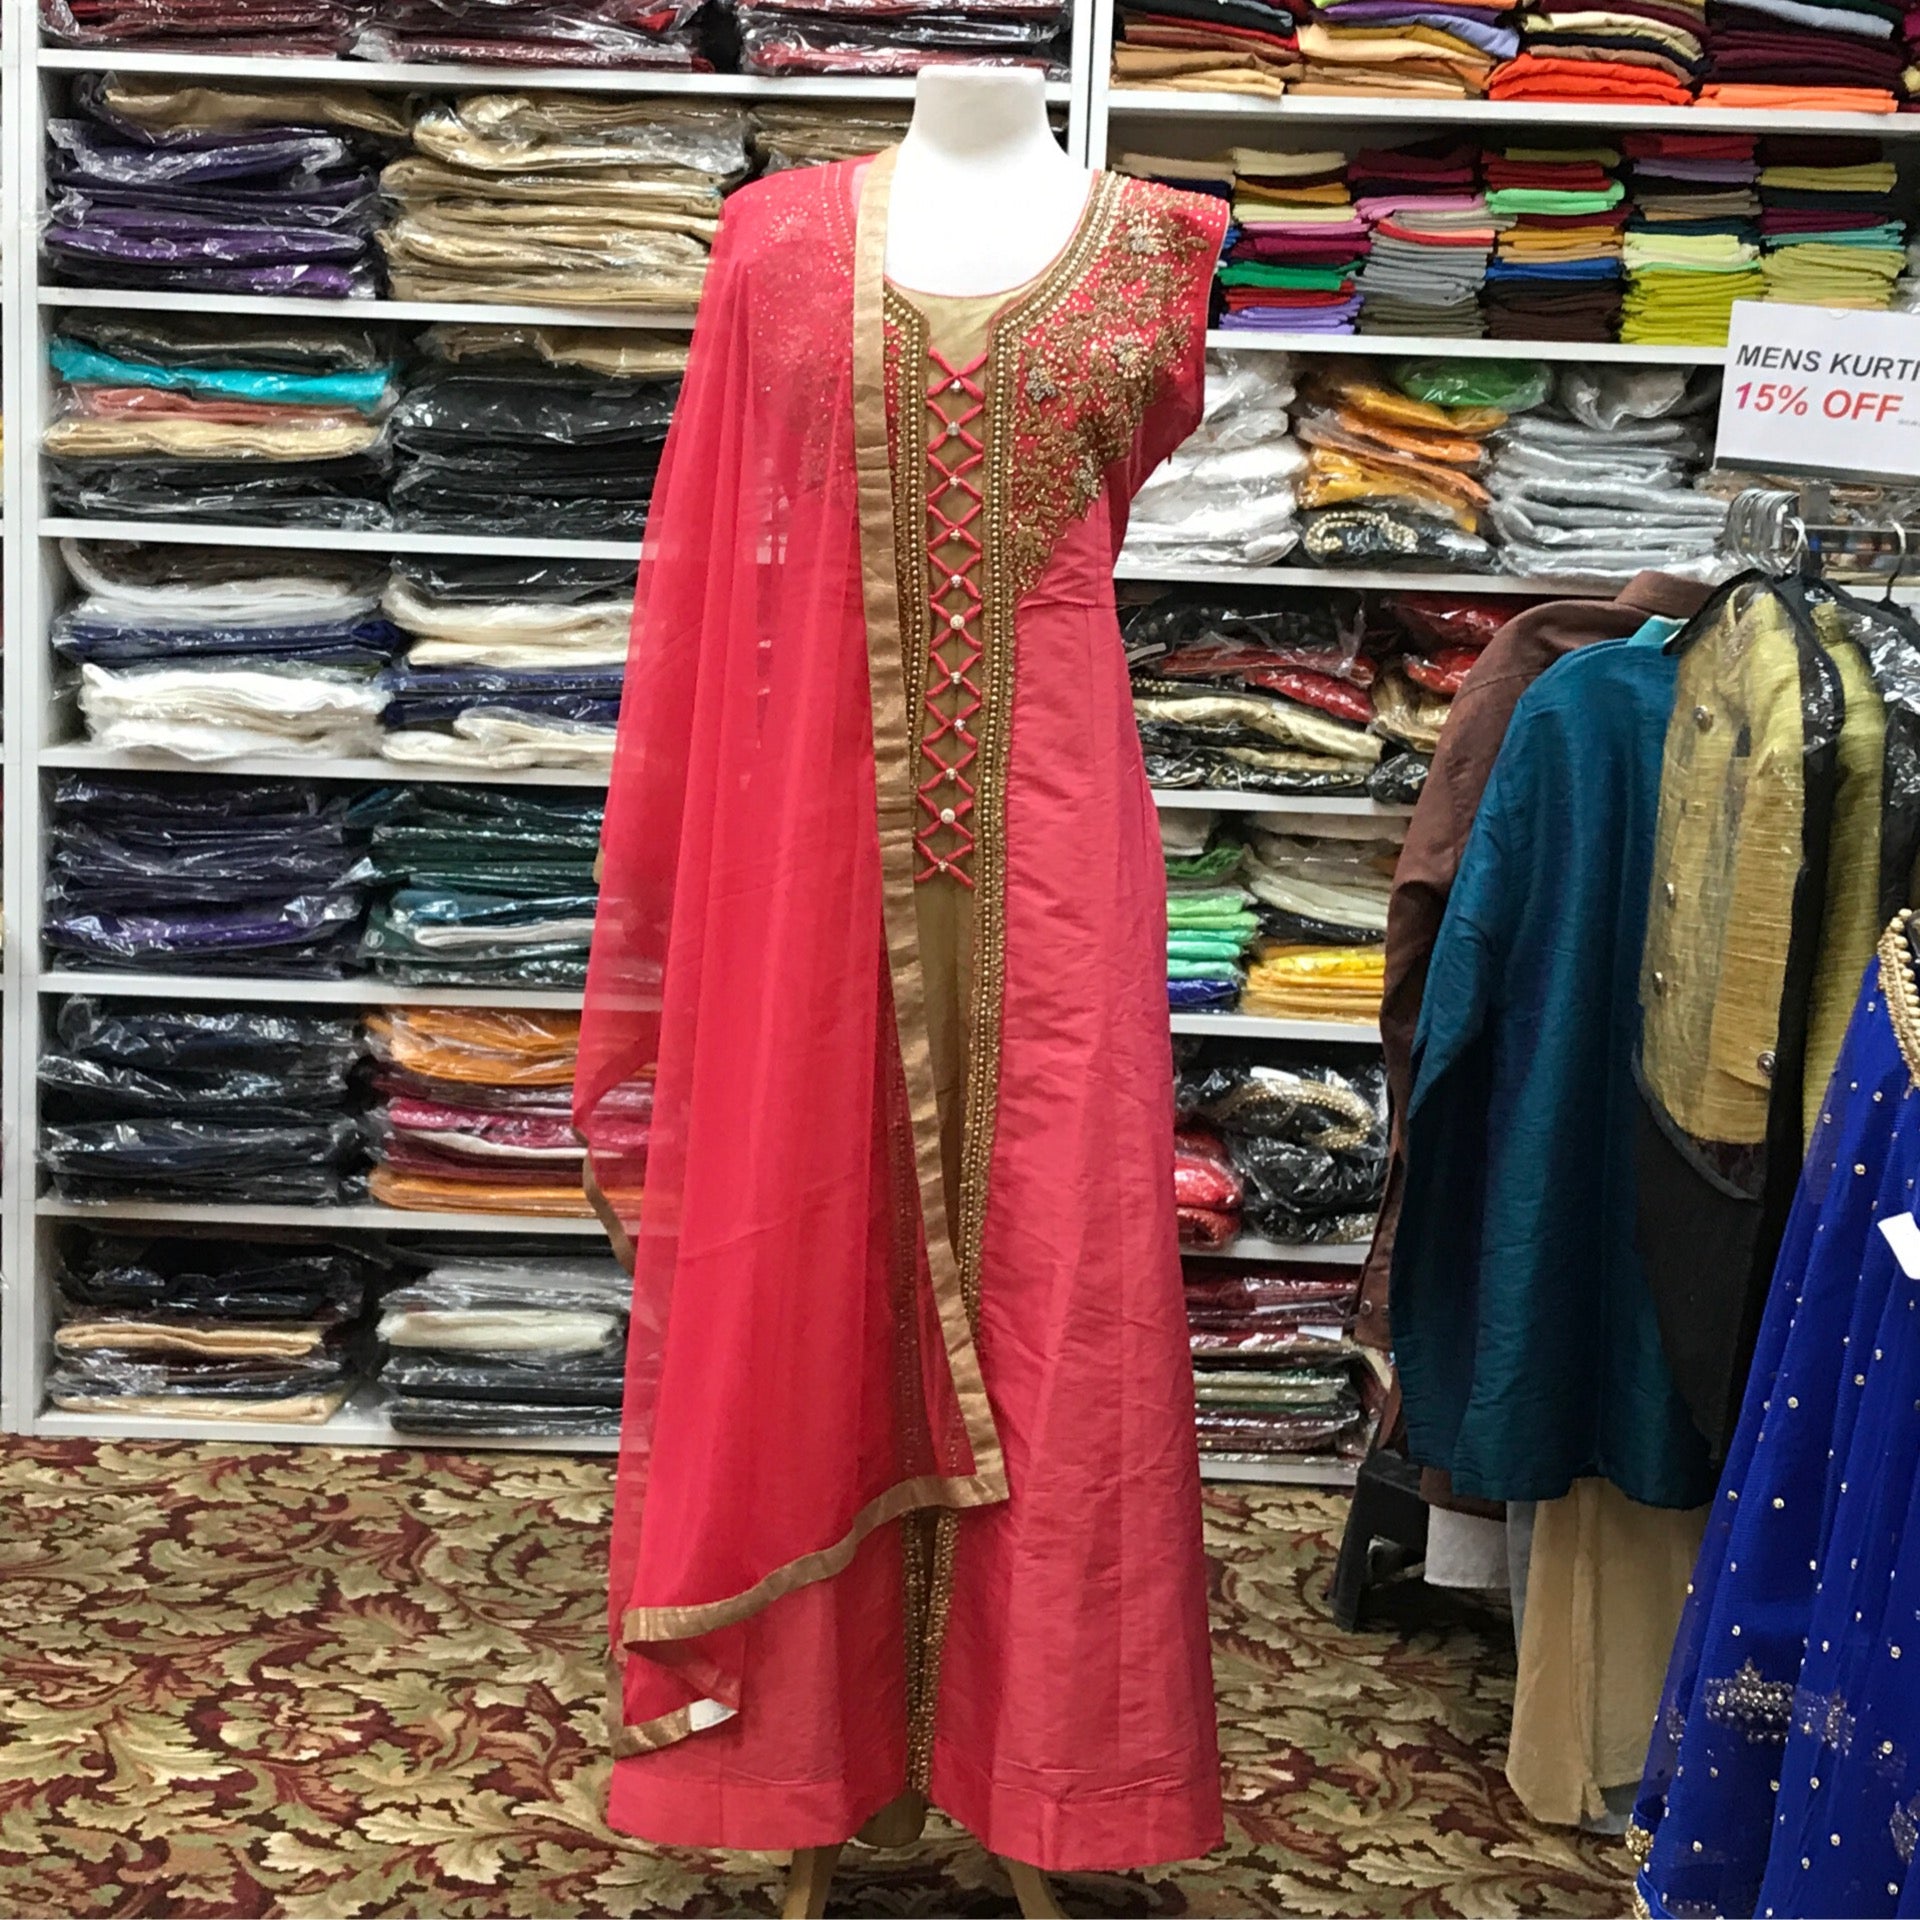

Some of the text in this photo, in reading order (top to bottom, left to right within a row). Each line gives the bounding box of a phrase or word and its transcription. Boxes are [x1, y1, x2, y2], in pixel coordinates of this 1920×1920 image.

[1736, 344, 1822, 372] MENS
[1735, 381, 1904, 422] 15% OFF
